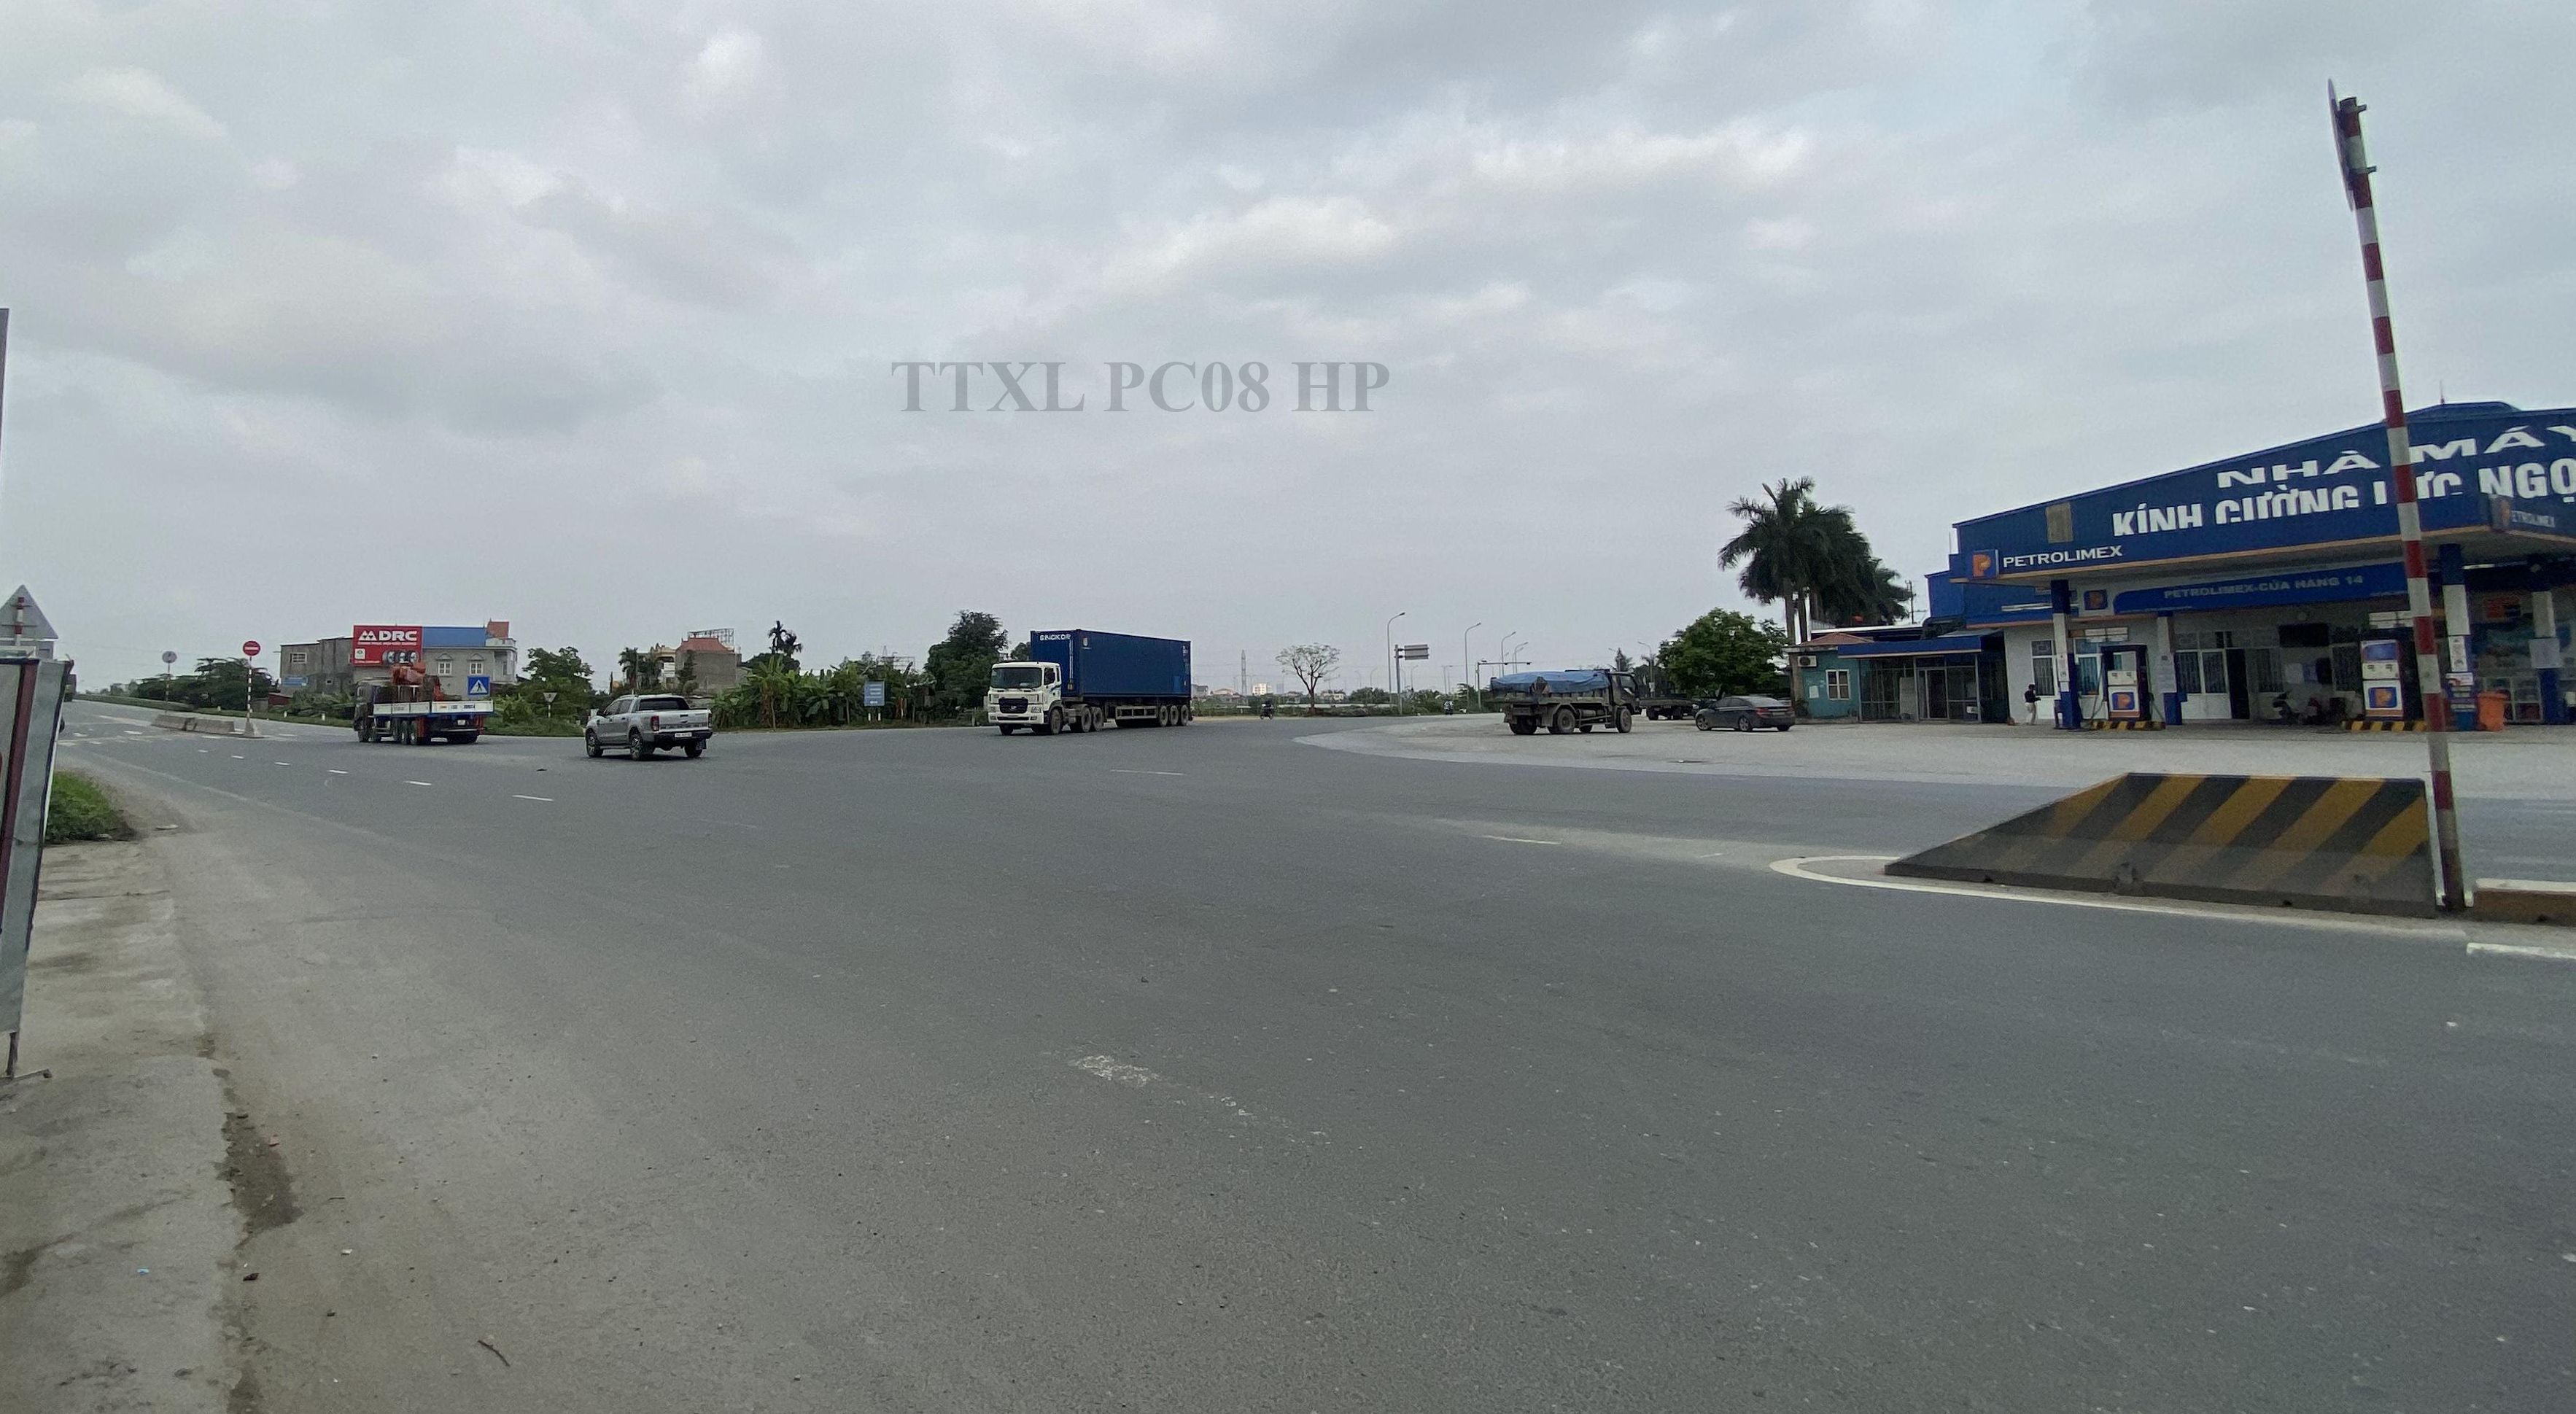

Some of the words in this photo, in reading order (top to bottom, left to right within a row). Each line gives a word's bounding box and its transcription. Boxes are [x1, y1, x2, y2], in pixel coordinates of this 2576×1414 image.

[2216, 449, 2381, 489] NHÀ
[2111, 502, 2203, 537] KÍNH
[2003, 545, 2124, 568] PETROLIMEX
[2345, 575, 2364, 585] 14
[379, 630, 418, 641] DRC
